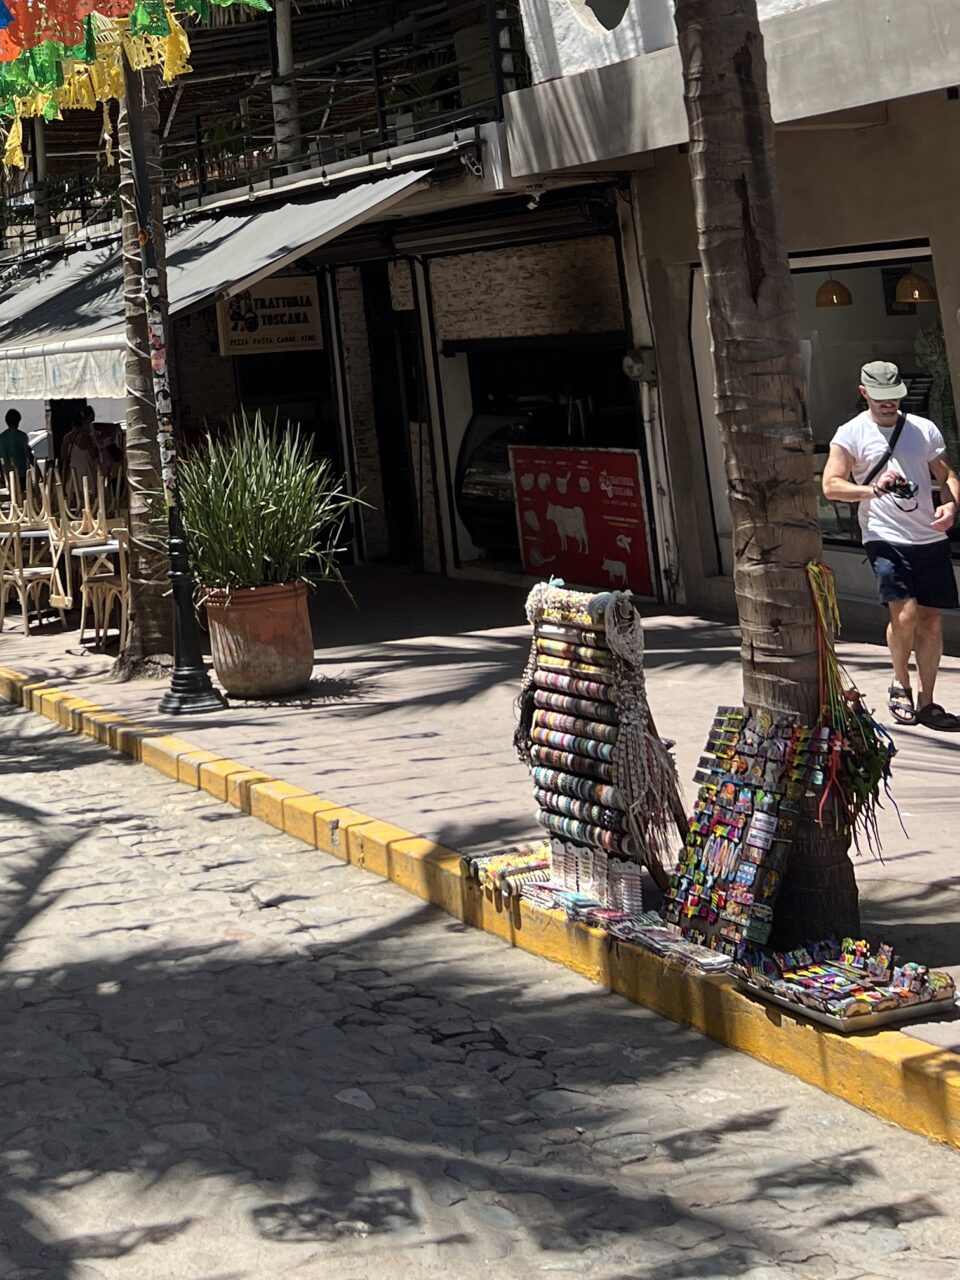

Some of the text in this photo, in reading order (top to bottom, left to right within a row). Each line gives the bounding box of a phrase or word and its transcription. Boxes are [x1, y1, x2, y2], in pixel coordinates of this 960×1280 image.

[253, 296, 313, 310] TRATTORIA
[261, 312, 310, 326] TOSCANA
[253, 337, 273, 345] PASTA
